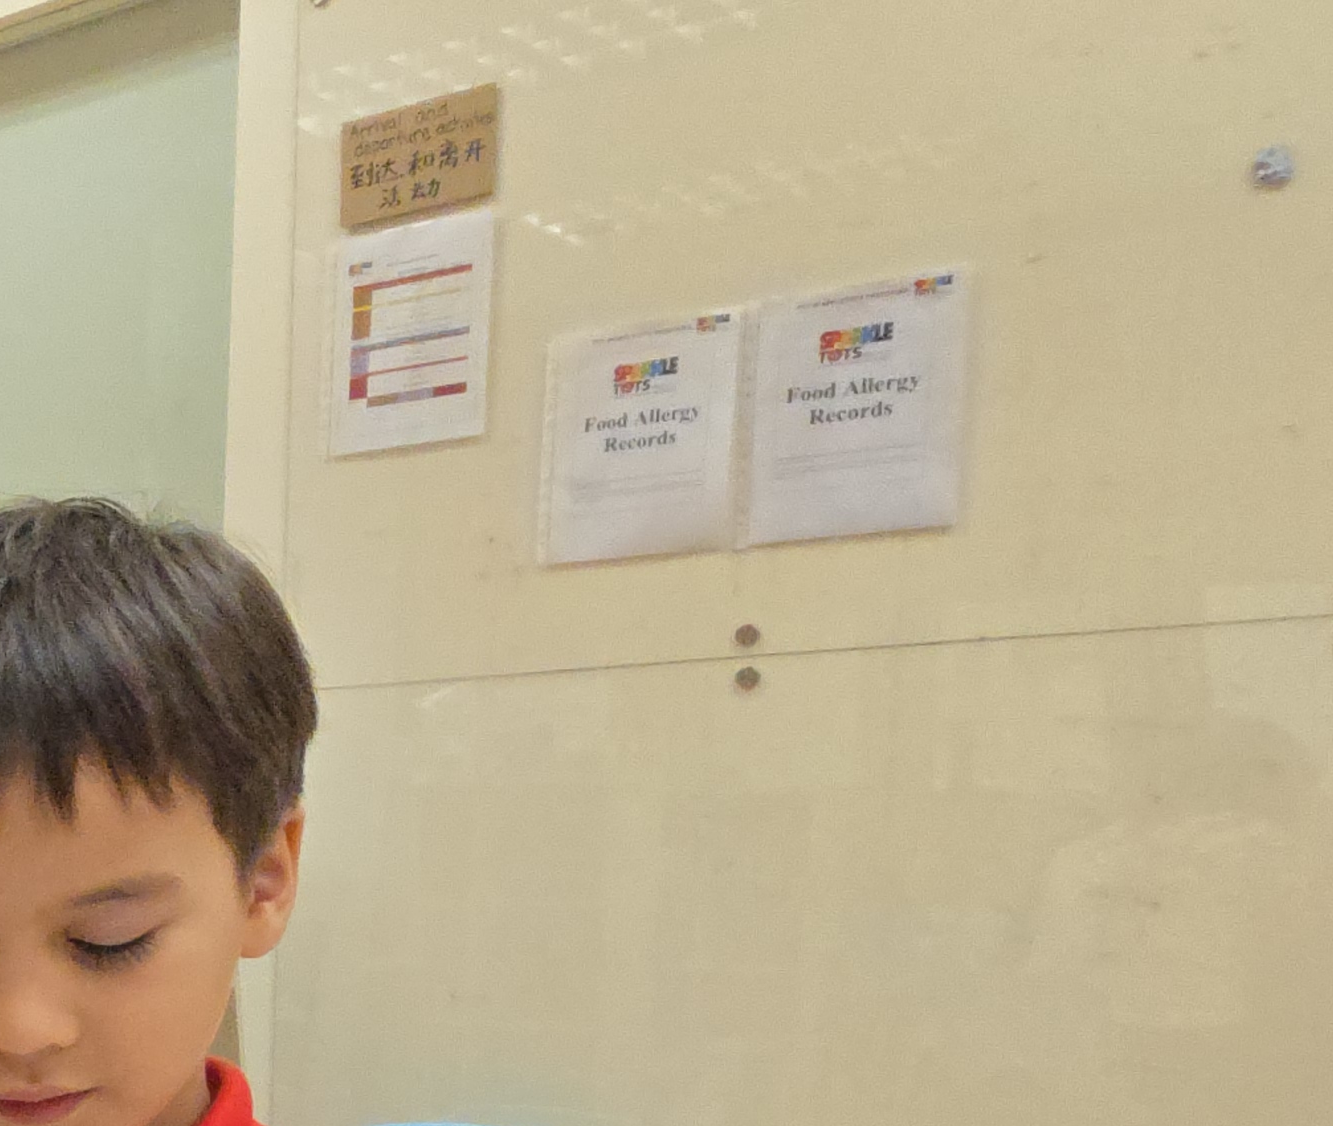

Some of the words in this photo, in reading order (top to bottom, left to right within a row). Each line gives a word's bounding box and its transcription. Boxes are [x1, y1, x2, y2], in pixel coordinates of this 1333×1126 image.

[786, 382, 836, 404] Food
[843, 375, 919, 396] Allergy
[584, 413, 628, 433] Food
[635, 406, 699, 426] Allergy
[809, 402, 894, 425] Records
[603, 431, 677, 453] Records
